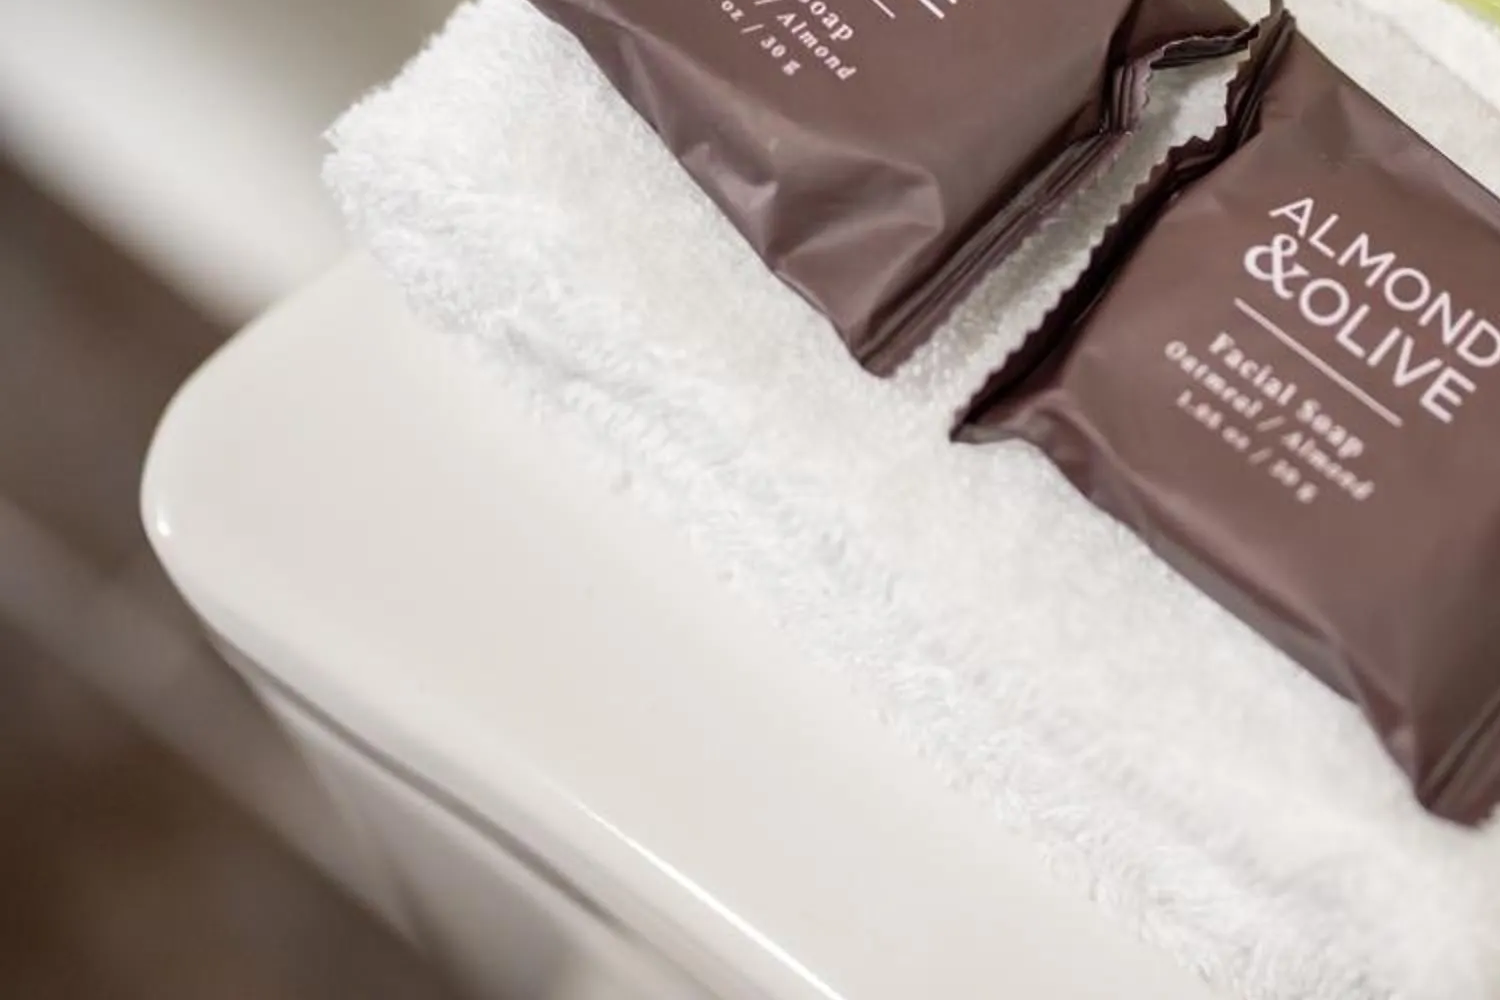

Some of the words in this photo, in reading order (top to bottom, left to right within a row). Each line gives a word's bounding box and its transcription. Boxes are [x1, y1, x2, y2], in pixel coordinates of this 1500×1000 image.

[759, 35, 787, 59] 30
[781, 59, 803, 77] g
[775, 10, 858, 81] Almond
[1163, 339, 1265, 418] Oatmeal
[1208, 331, 1298, 407] Facial
[1295, 398, 1365, 460] Soap
